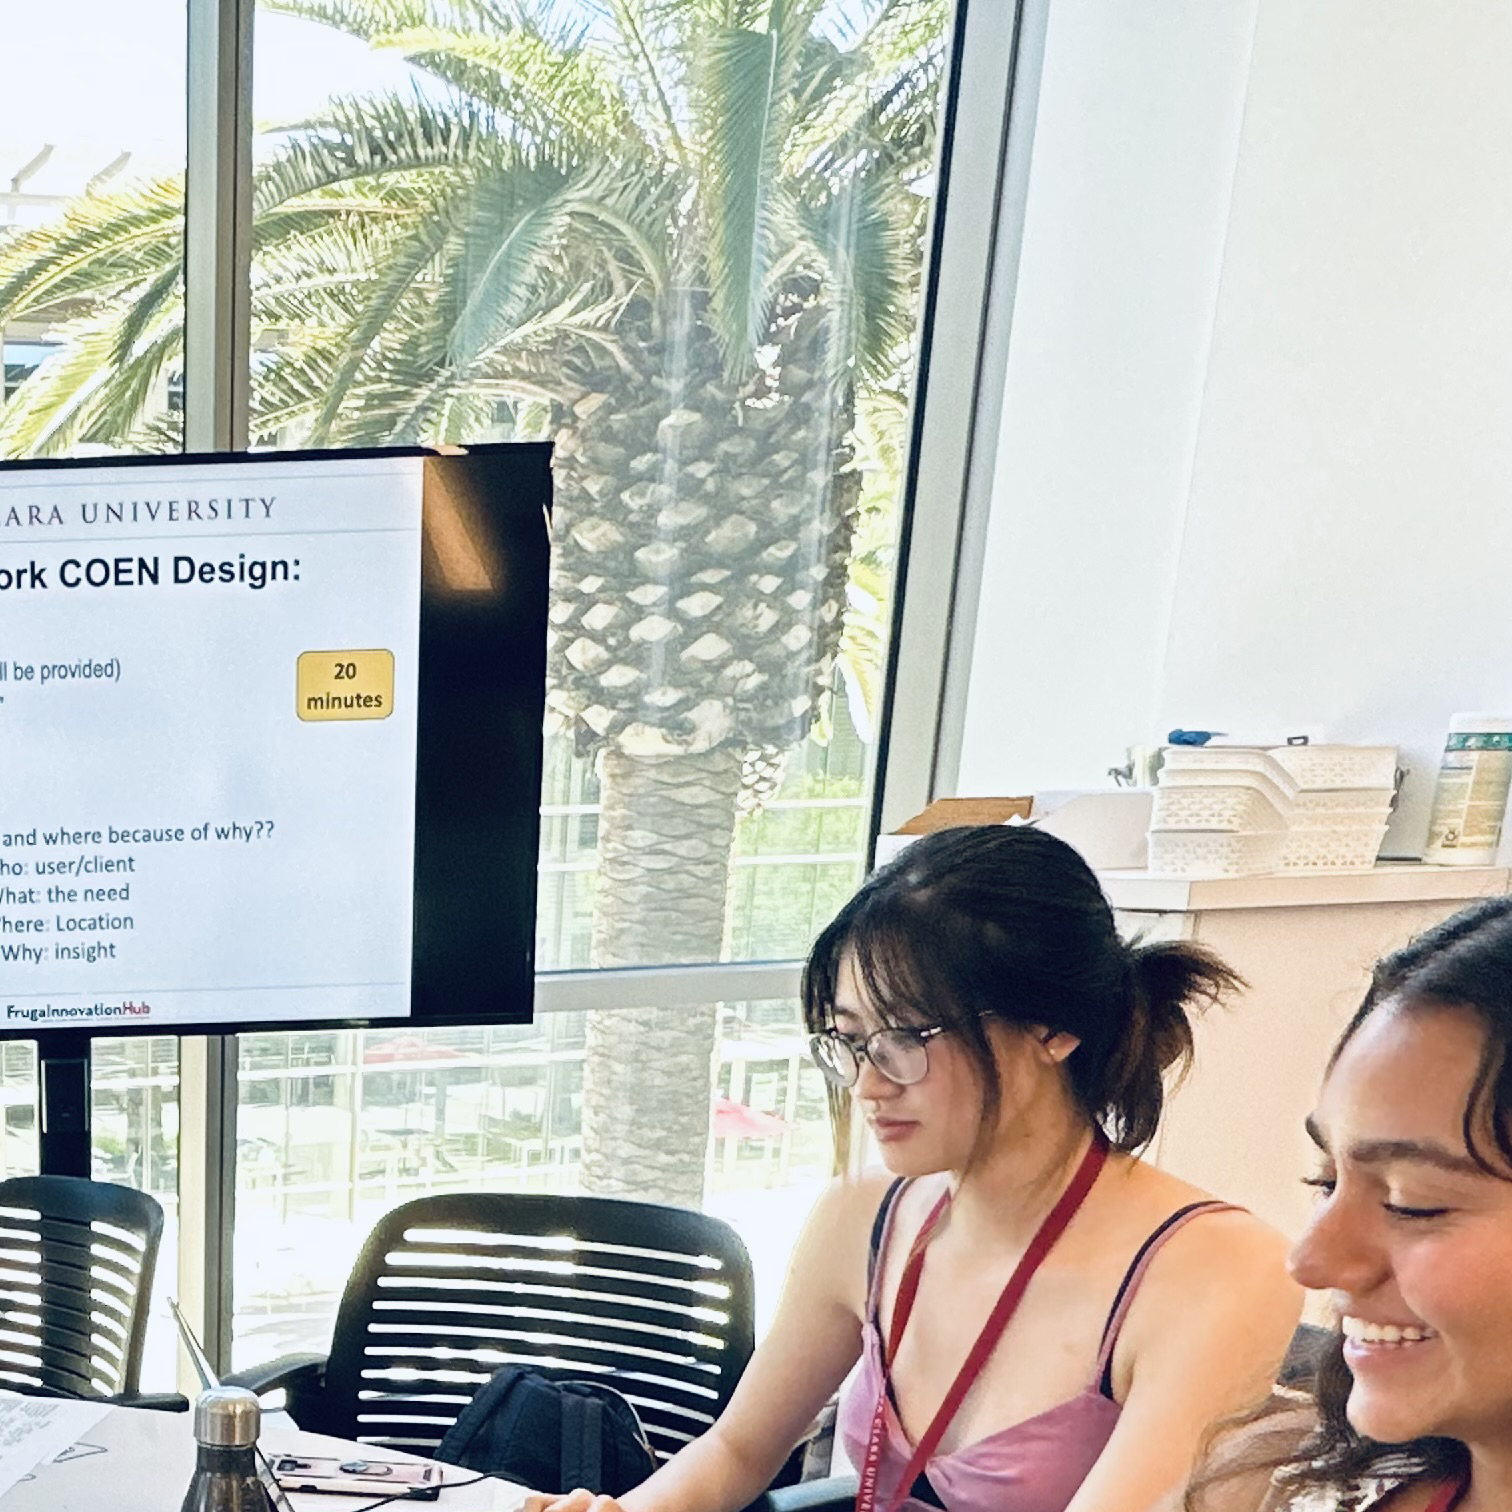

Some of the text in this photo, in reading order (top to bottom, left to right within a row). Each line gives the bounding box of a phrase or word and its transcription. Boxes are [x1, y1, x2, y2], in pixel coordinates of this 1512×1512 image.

[81, 498, 277, 525] UNIVERSITY
[59, 556, 160, 588] COEN
[174, 554, 301, 590] Design:
[13, 660, 34, 681] be
[40, 658, 121, 685] provided)
[333, 662, 357, 681] 20
[306, 690, 383, 711] minutes
[2, 829, 37, 847] and
[42, 827, 102, 846] where
[108, 826, 185, 845] because
[190, 823, 210, 841] of
[214, 821, 275, 846] why??
[35, 856, 136, 878] user/client
[46, 885, 78, 902] the
[83, 883, 130, 901] need
[56, 914, 135, 932] Location
[1, 942, 117, 965] Why: insight
